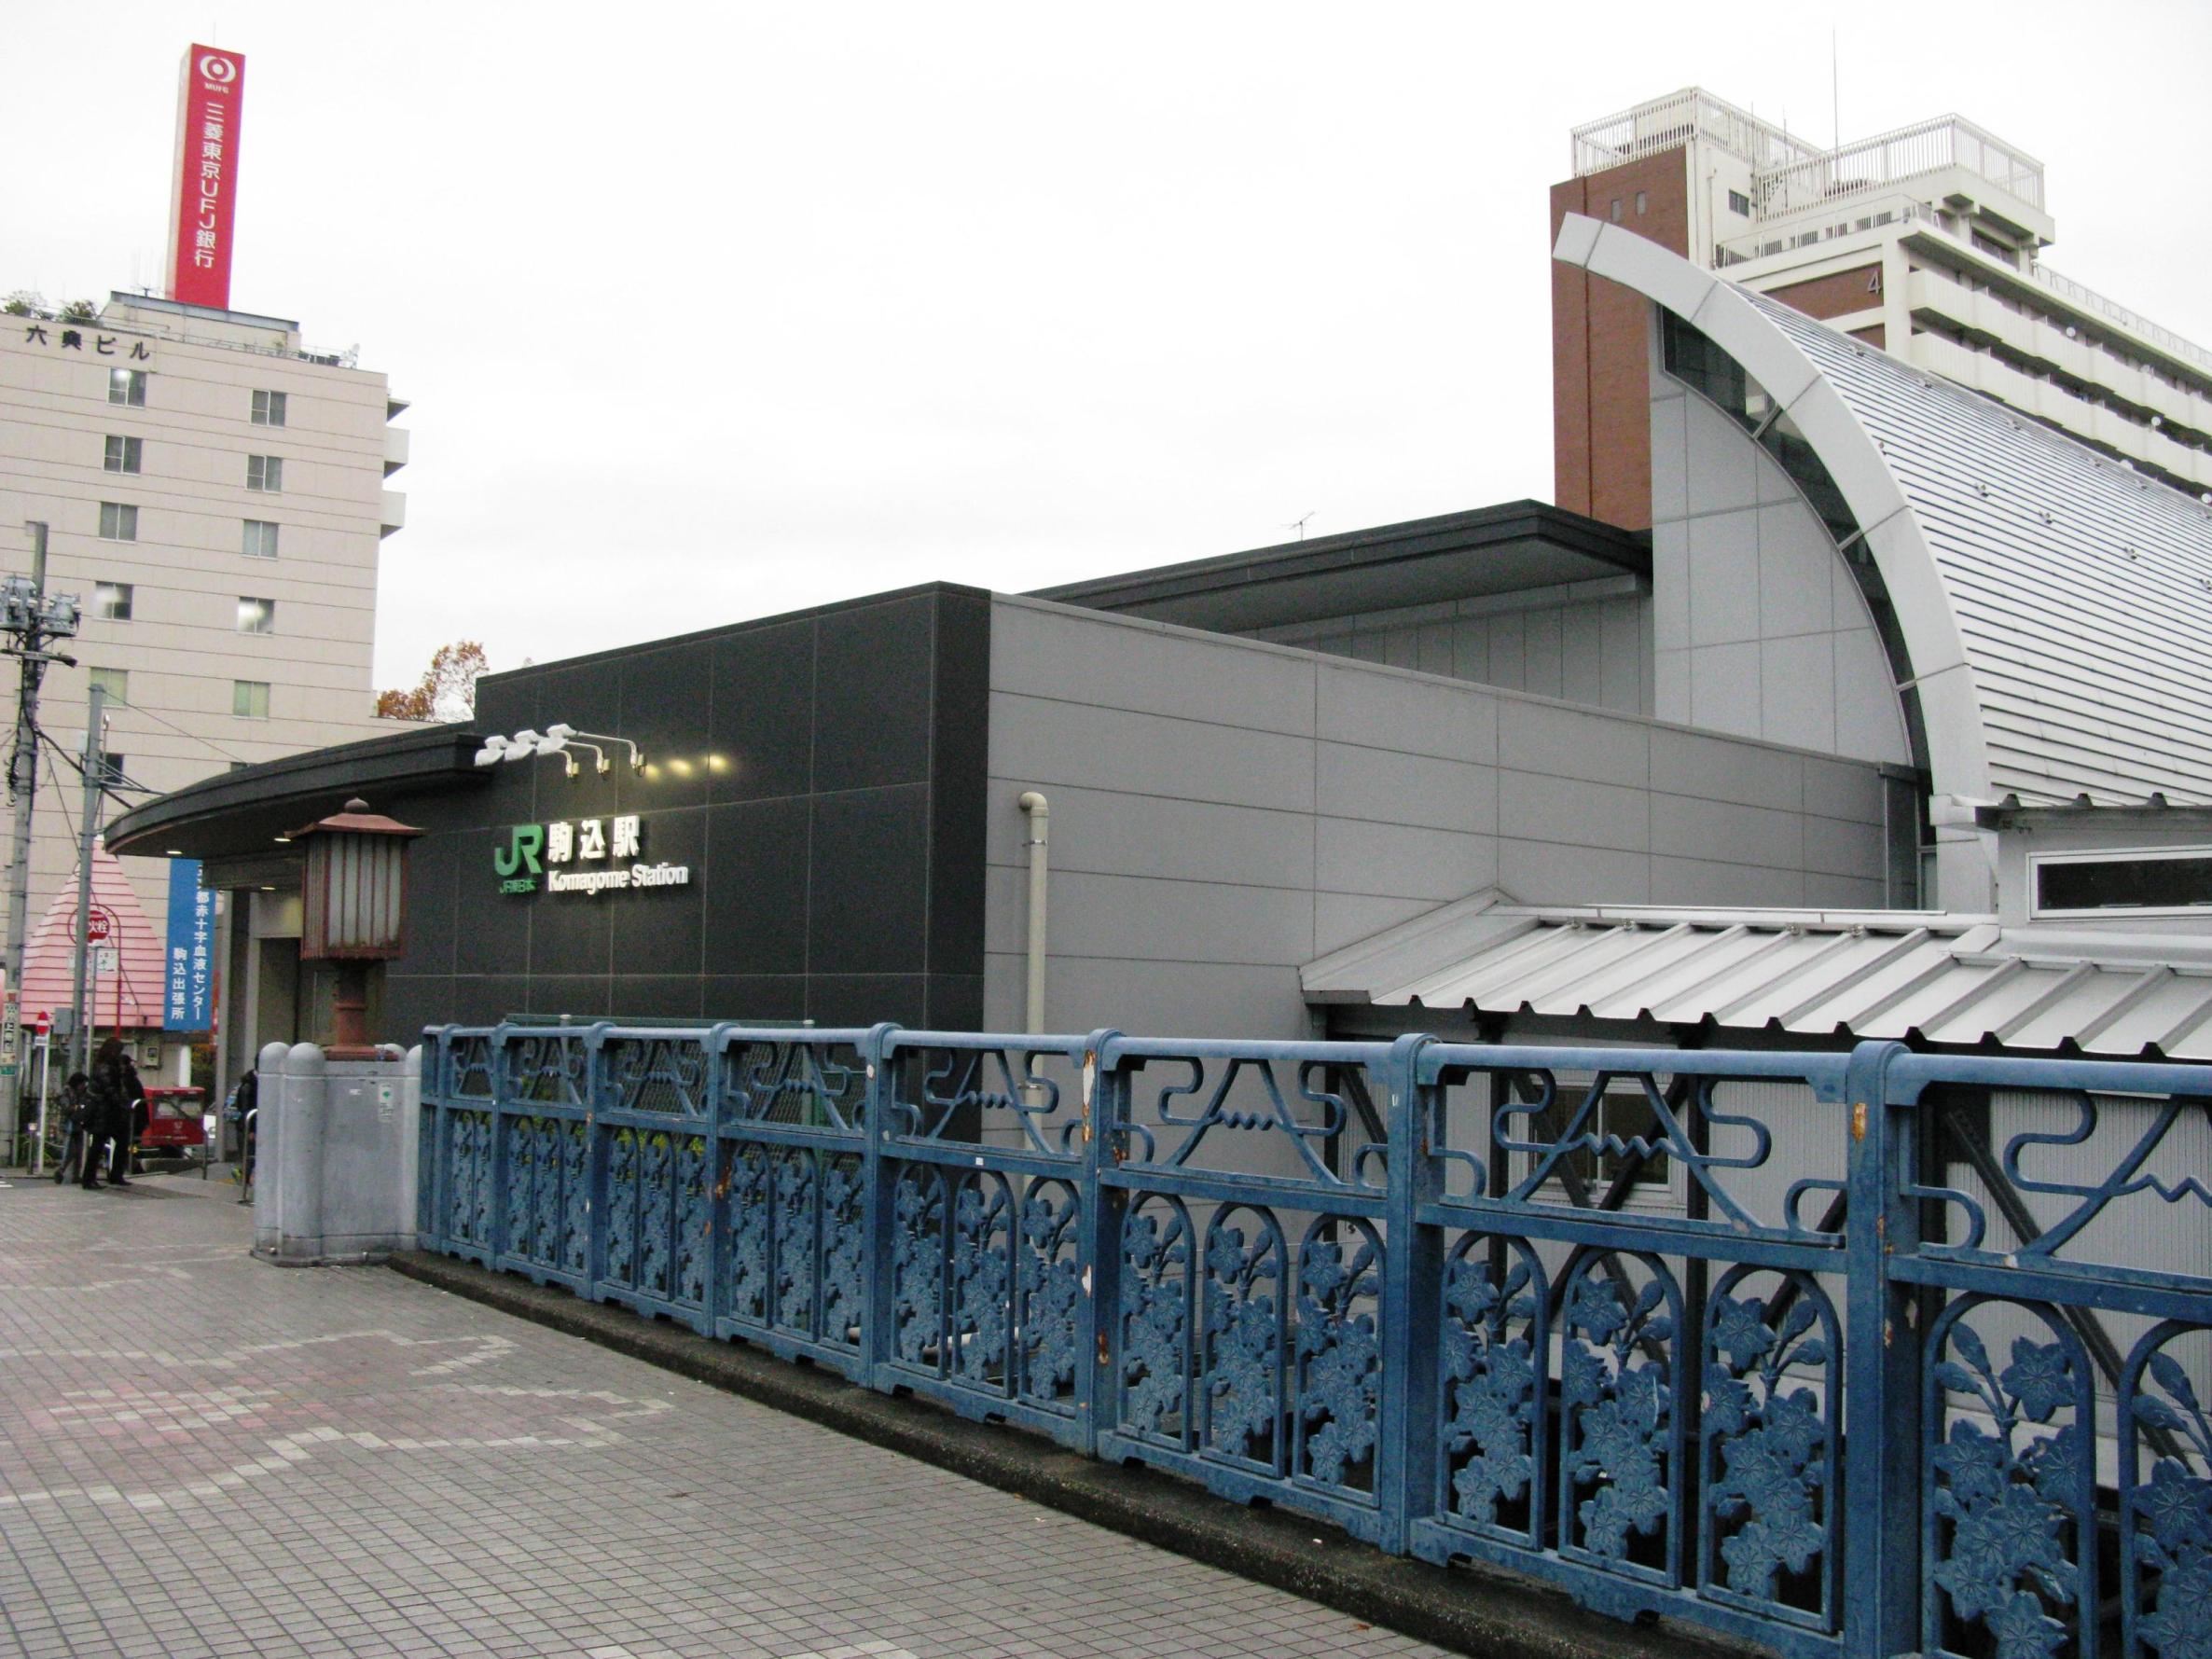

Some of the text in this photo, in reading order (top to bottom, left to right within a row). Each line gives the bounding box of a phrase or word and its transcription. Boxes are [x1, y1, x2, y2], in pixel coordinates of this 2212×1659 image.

[204, 82, 229, 94] MUFG
[195, 101, 225, 270] 三菱東京UFJ銀行
[1867, 270, 1881, 295] 4
[494, 824, 545, 877] JR
[547, 815, 641, 863] 駒込駅
[548, 862, 689, 896] Komagome Station
[192, 864, 211, 1020] 都赤十字血液センター
[171, 947, 188, 1020] 駒込出張所
